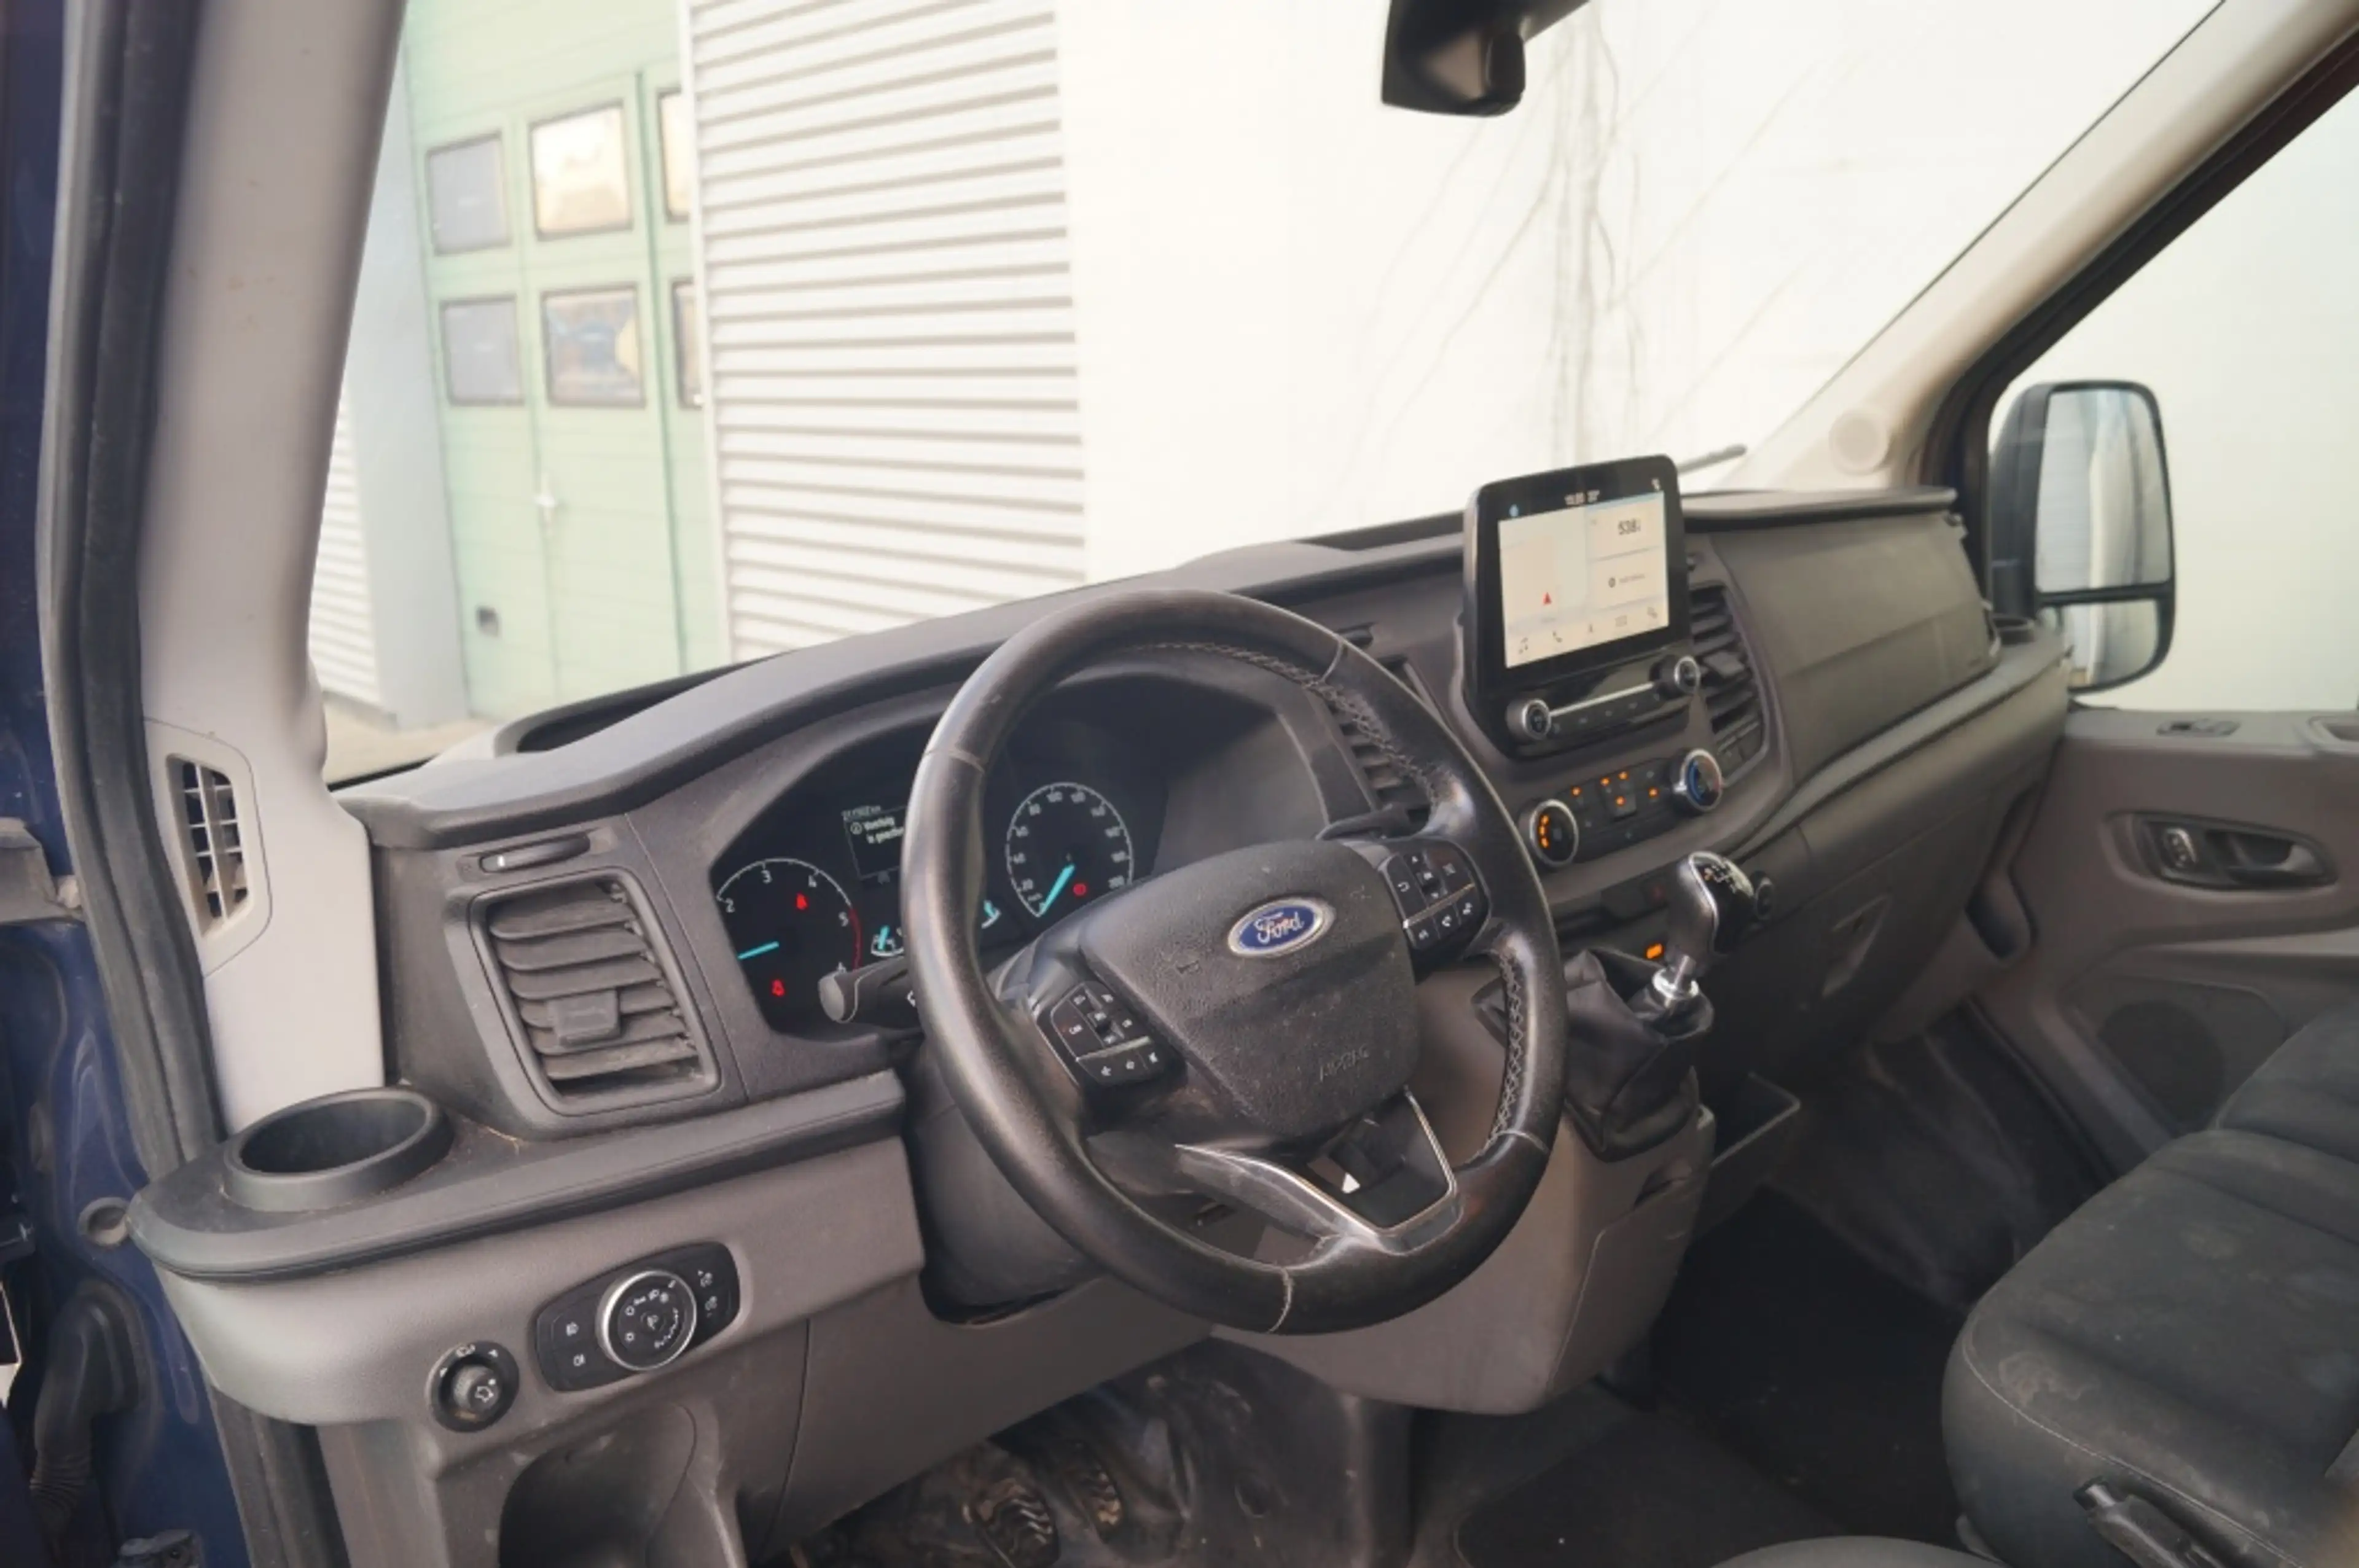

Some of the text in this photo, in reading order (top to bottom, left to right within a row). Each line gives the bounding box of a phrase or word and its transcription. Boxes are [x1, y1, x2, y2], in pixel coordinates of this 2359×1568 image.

[762, 869, 772, 883] 3
[808, 875, 817, 887] 4
[725, 898, 735, 913] 2
[839, 911, 848, 927] 5
[1253, 911, 1305, 944] Ford
